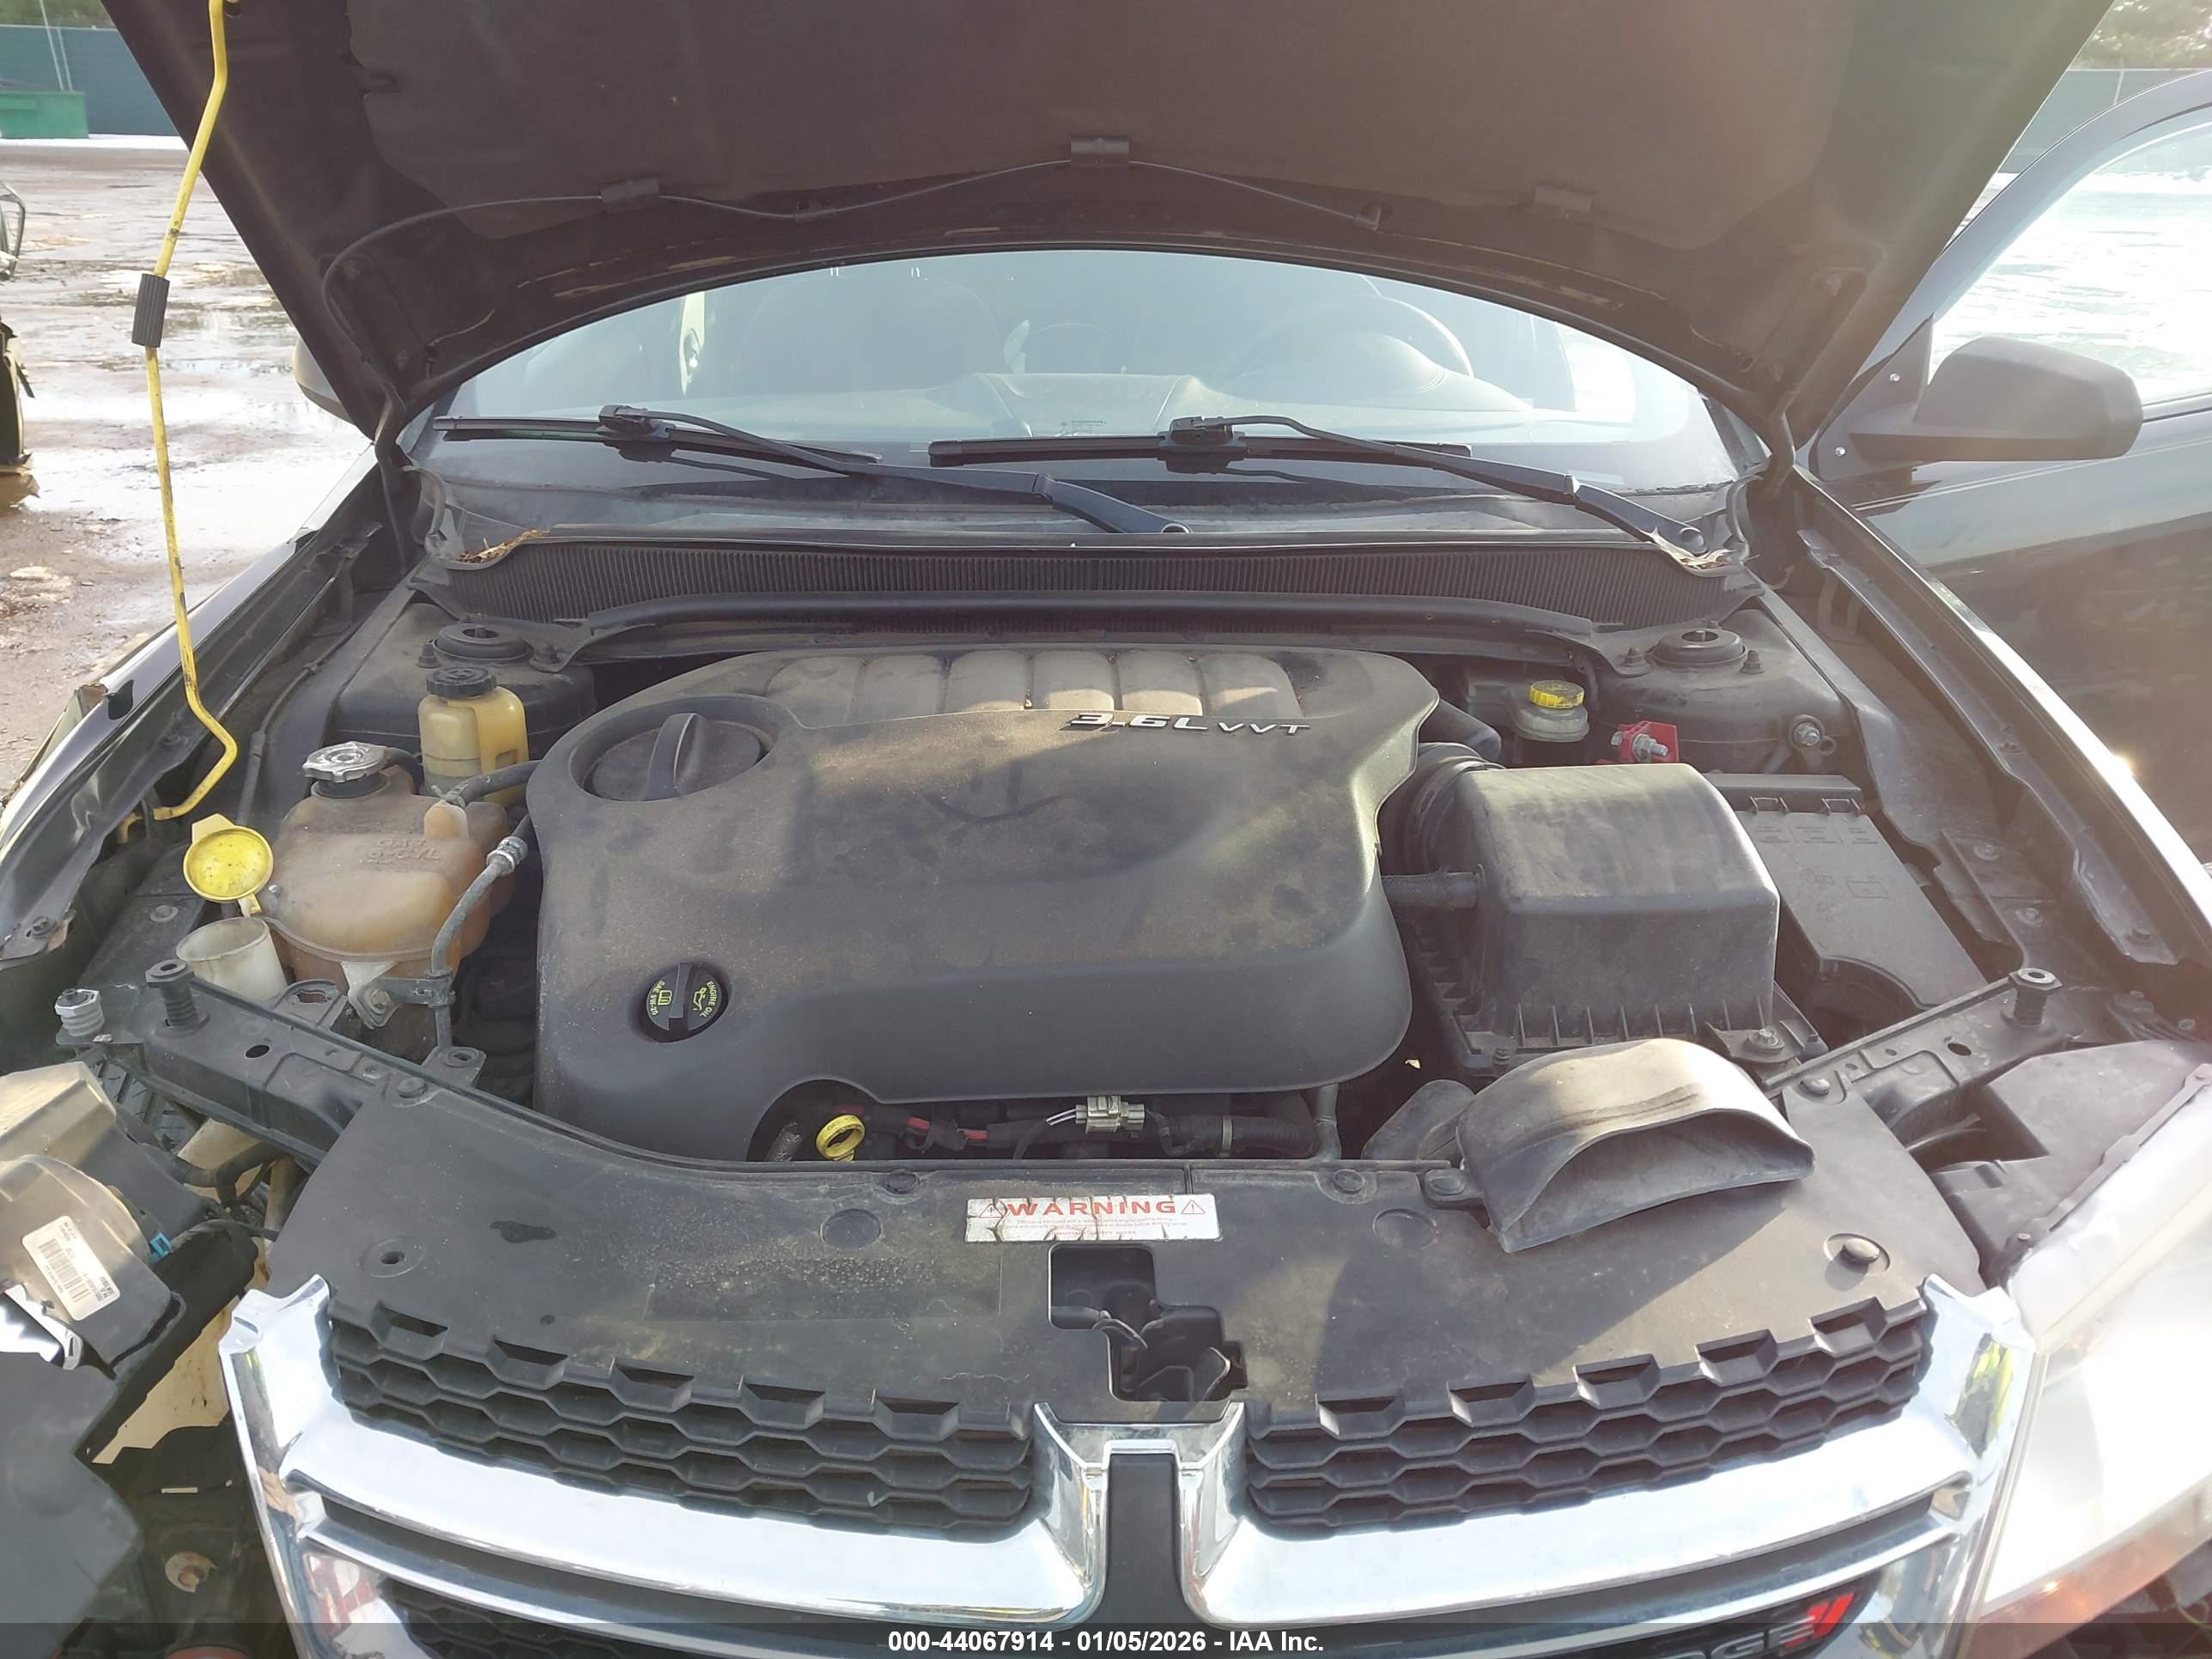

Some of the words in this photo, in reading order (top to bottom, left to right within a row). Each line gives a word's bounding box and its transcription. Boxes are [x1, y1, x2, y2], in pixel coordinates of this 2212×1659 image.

[1071, 712, 1208, 731] 3.6L
[1218, 722, 1310, 734] VVT
[653, 980, 665, 993] SAE
[706, 981, 718, 1006] ENGINE
[699, 1006, 713, 1018] OIL
[1007, 1200, 1176, 1216] WARNING
